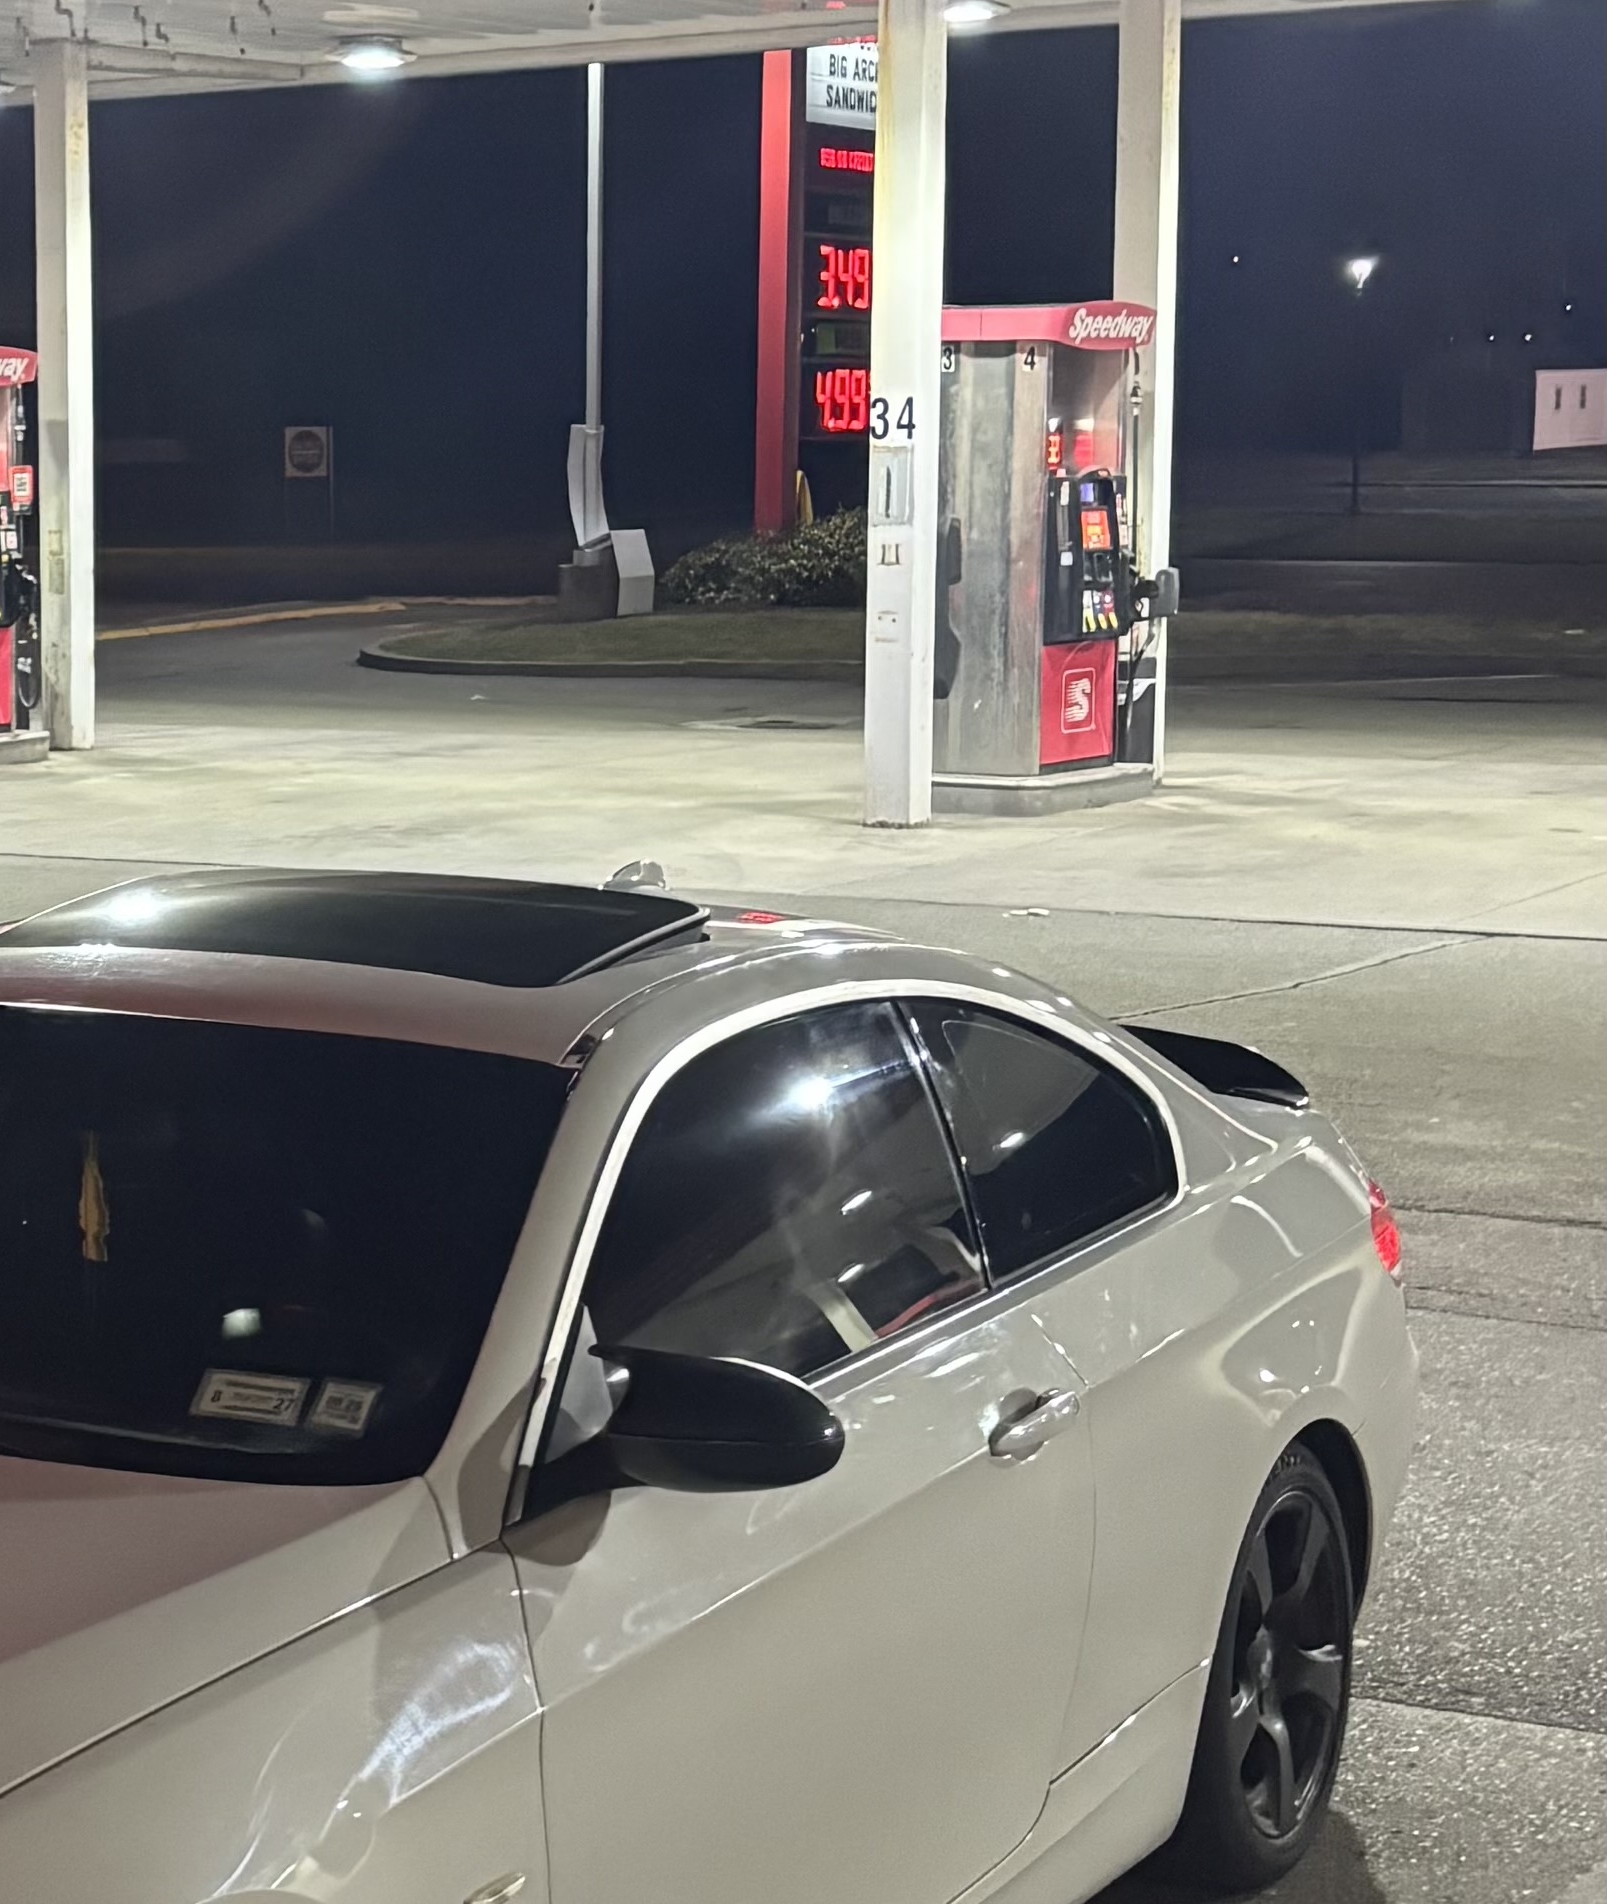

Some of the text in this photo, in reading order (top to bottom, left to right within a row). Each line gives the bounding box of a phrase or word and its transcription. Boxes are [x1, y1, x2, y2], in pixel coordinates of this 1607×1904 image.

[829, 53, 848, 79] BIG
[1068, 307, 1154, 345] Speedway
[942, 347, 953, 371] 3
[1023, 346, 1036, 371] 4
